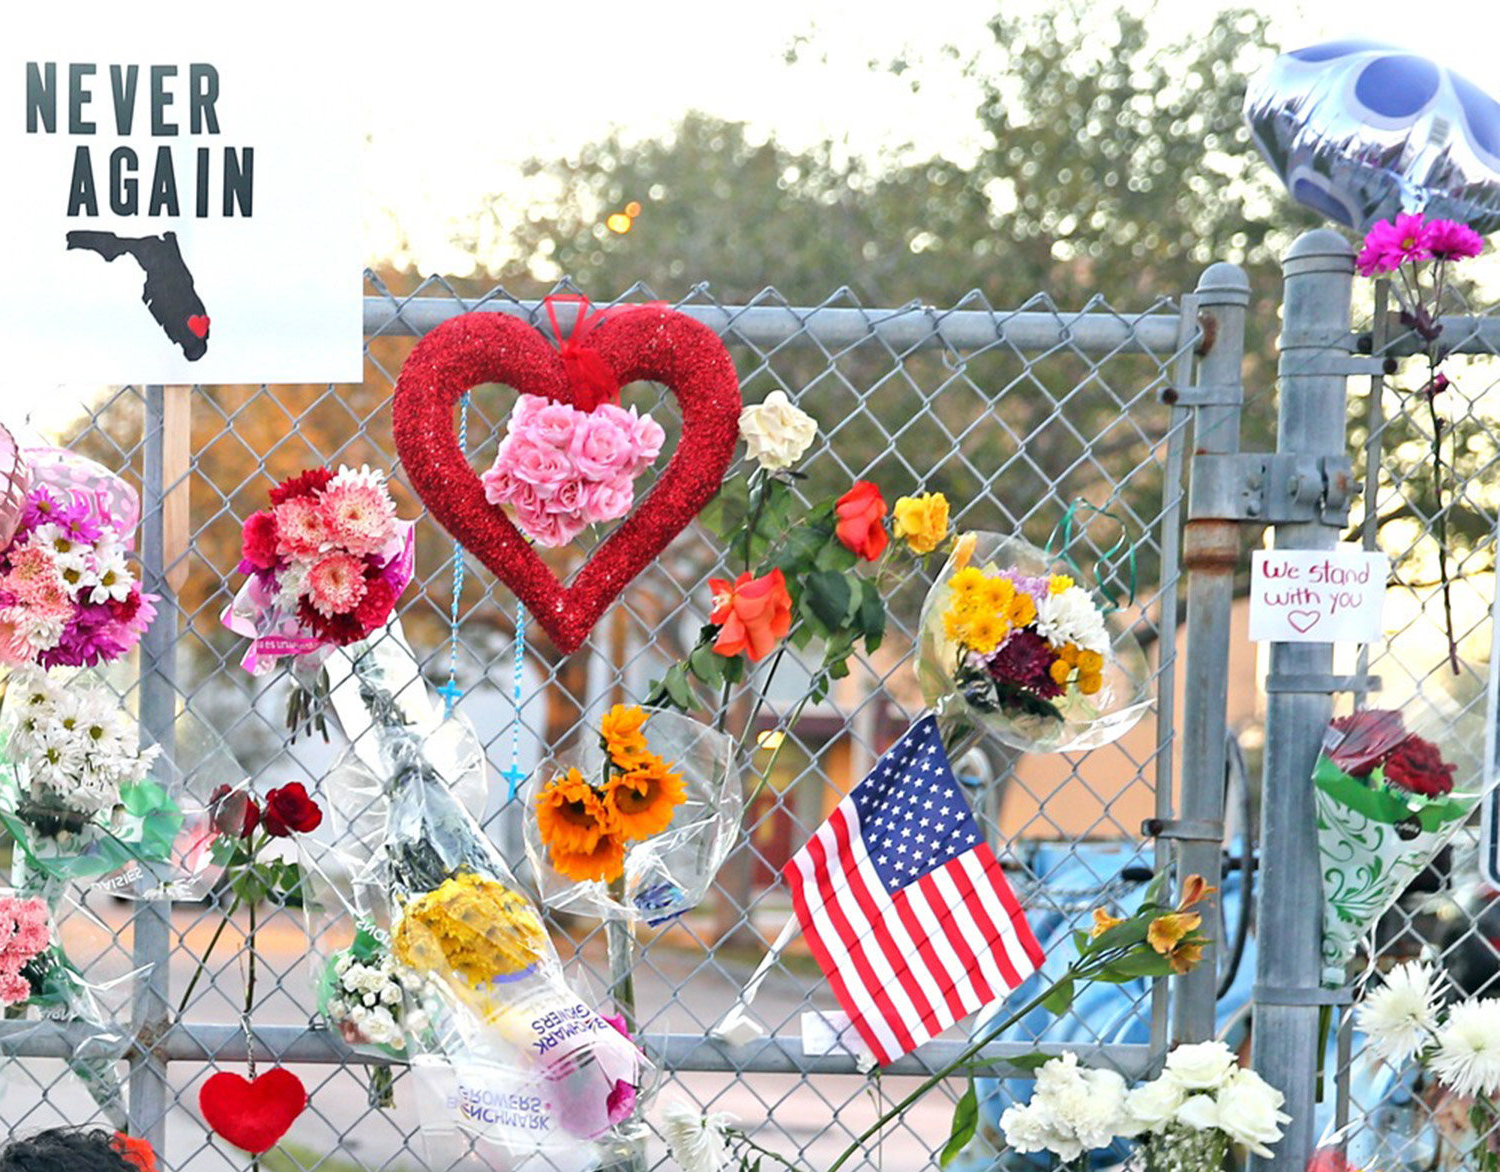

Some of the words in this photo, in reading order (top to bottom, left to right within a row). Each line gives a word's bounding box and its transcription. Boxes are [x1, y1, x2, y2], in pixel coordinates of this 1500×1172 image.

[26, 62, 221, 136] NEVER
[66, 145, 254, 218] AGAIN
[1263, 559, 1299, 579] We
[1309, 559, 1370, 585] stand
[1263, 586, 1321, 606] with
[1330, 591, 1363, 615] you
